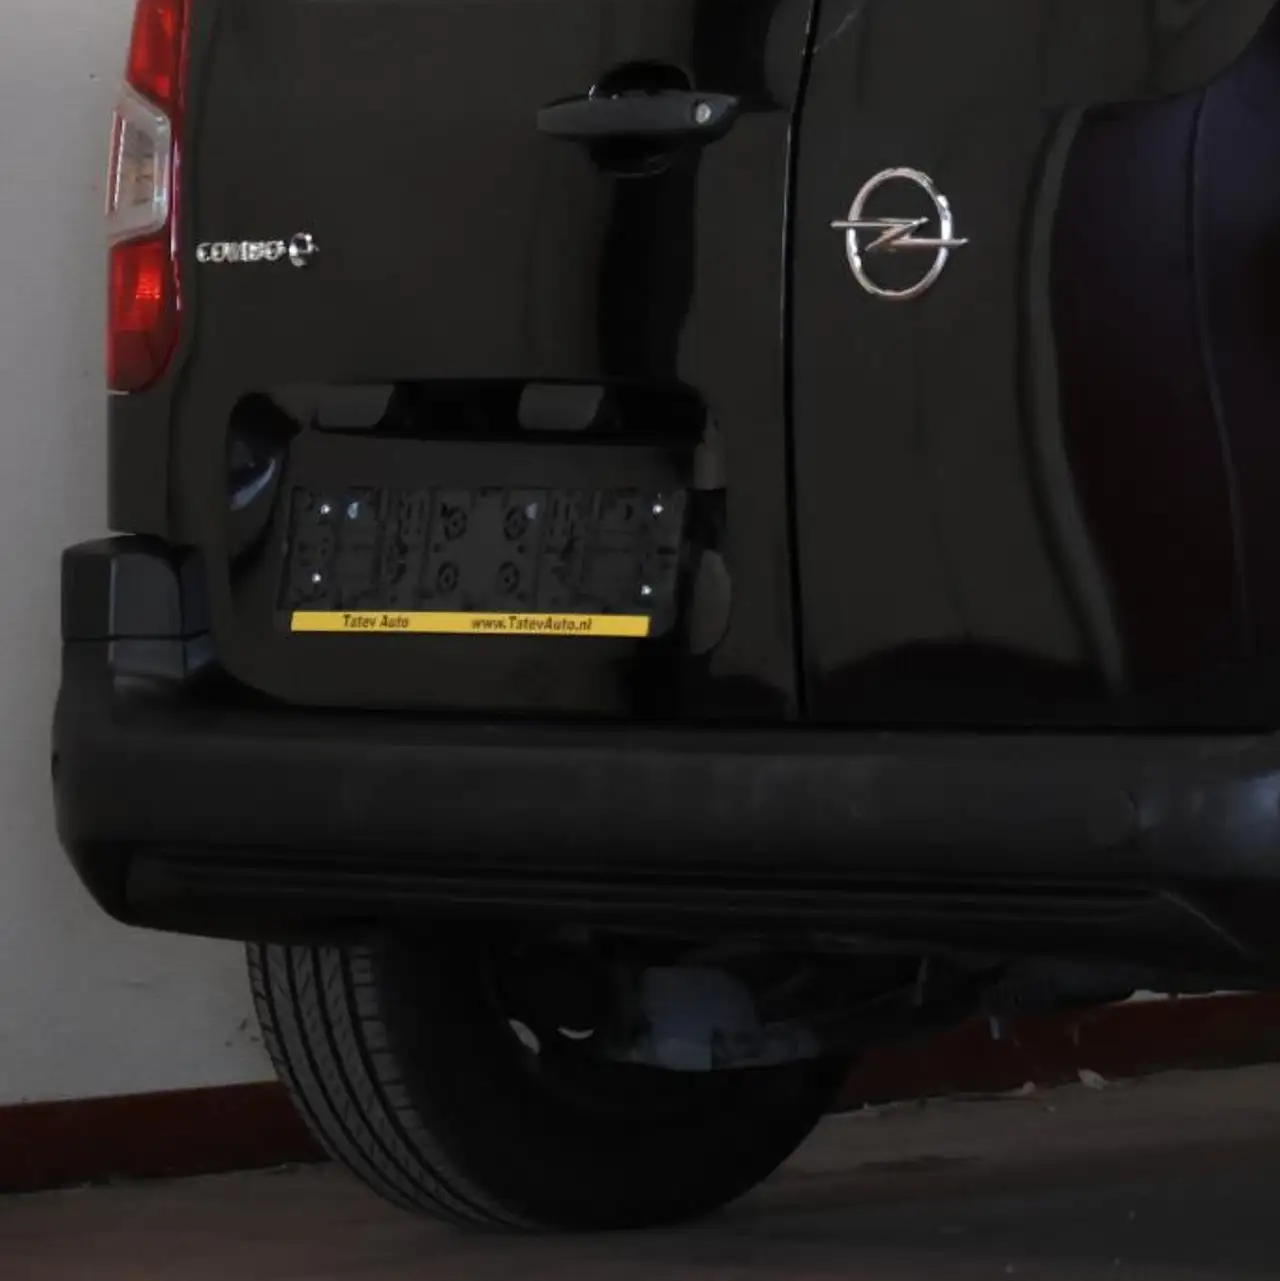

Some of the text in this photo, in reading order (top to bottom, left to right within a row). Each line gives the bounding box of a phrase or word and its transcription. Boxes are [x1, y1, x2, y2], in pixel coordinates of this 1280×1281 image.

[342, 613, 410, 629] Tatev Auto
[470, 614, 593, 631] www.TatevAuto.nl
